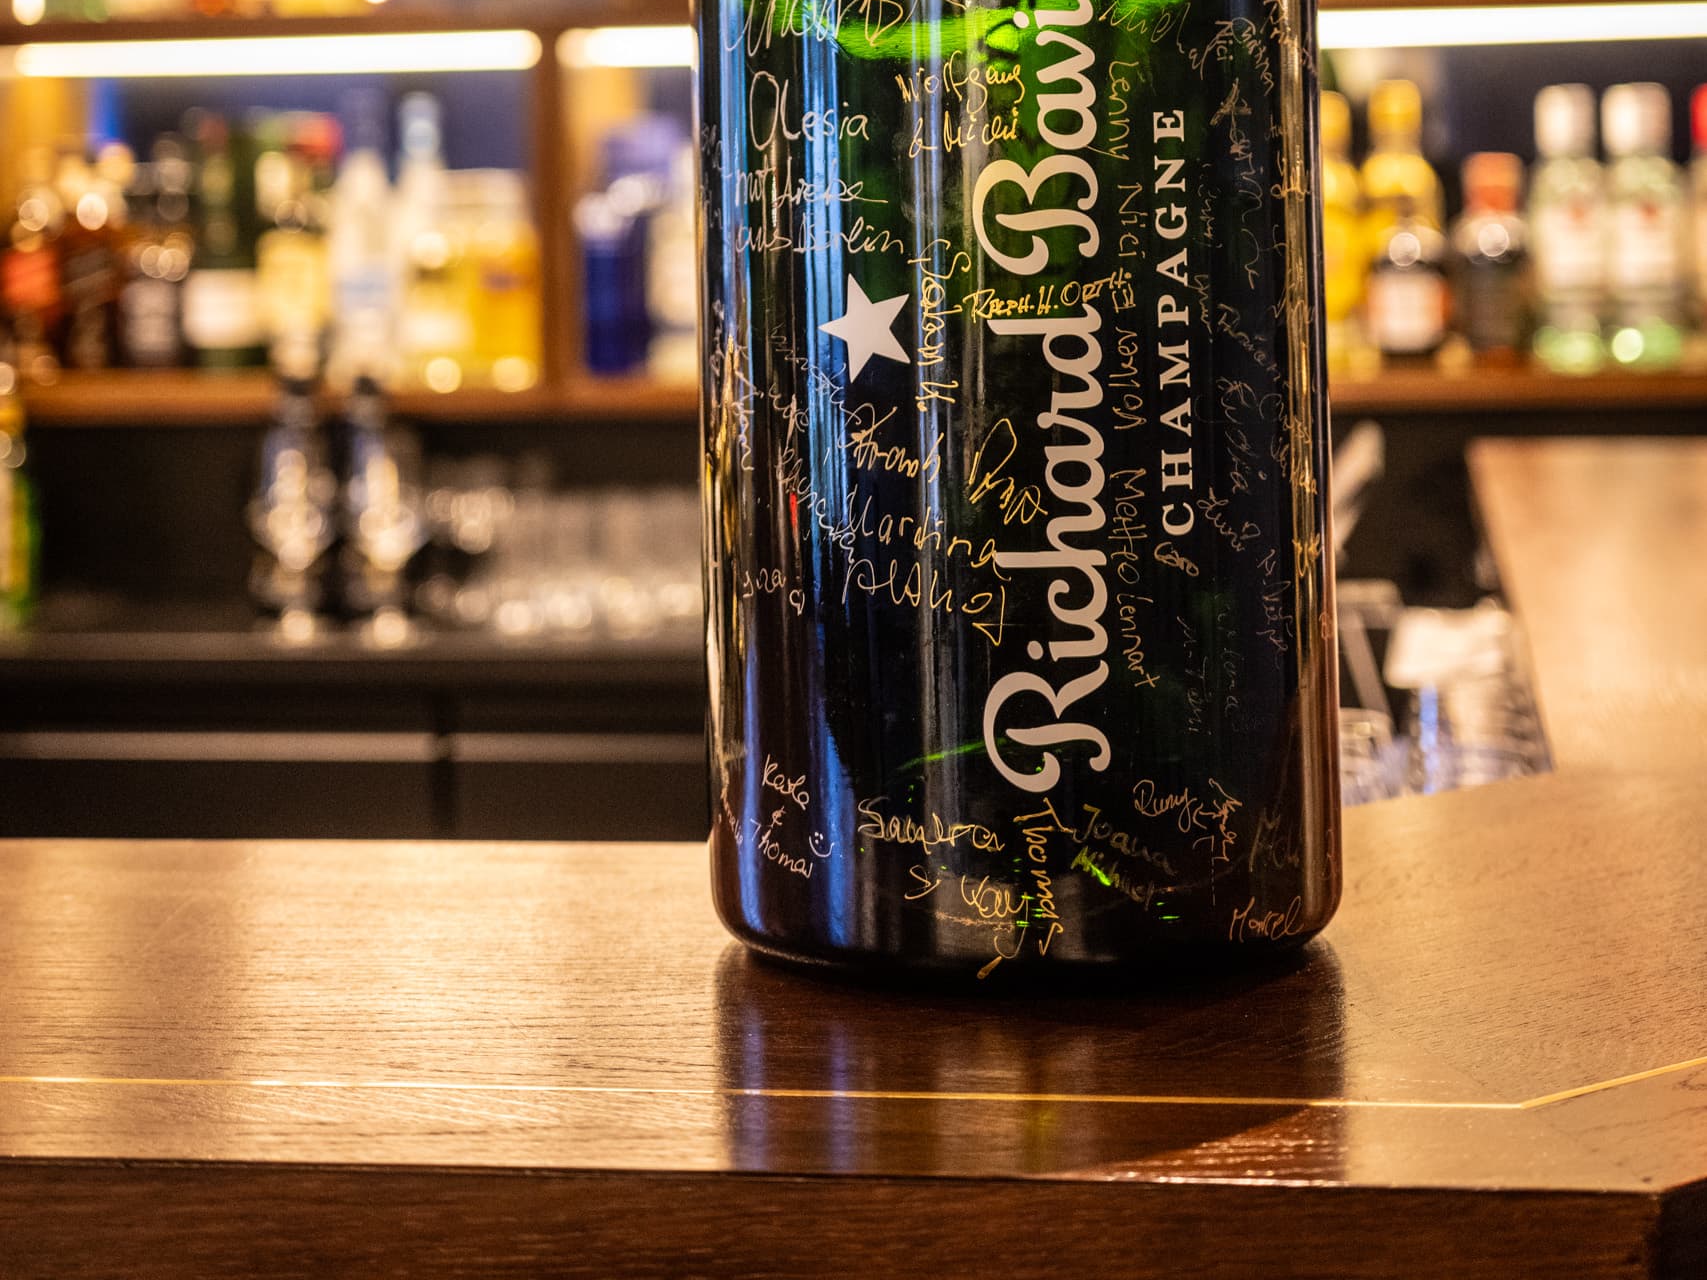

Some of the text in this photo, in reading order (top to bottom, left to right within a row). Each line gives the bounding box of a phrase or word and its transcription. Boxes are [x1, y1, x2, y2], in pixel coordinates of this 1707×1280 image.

[1153, 108, 1195, 537] CHAMPAGNE
[984, 303, 1111, 793] Richard
[1012, 796, 1066, 957] Thomas
